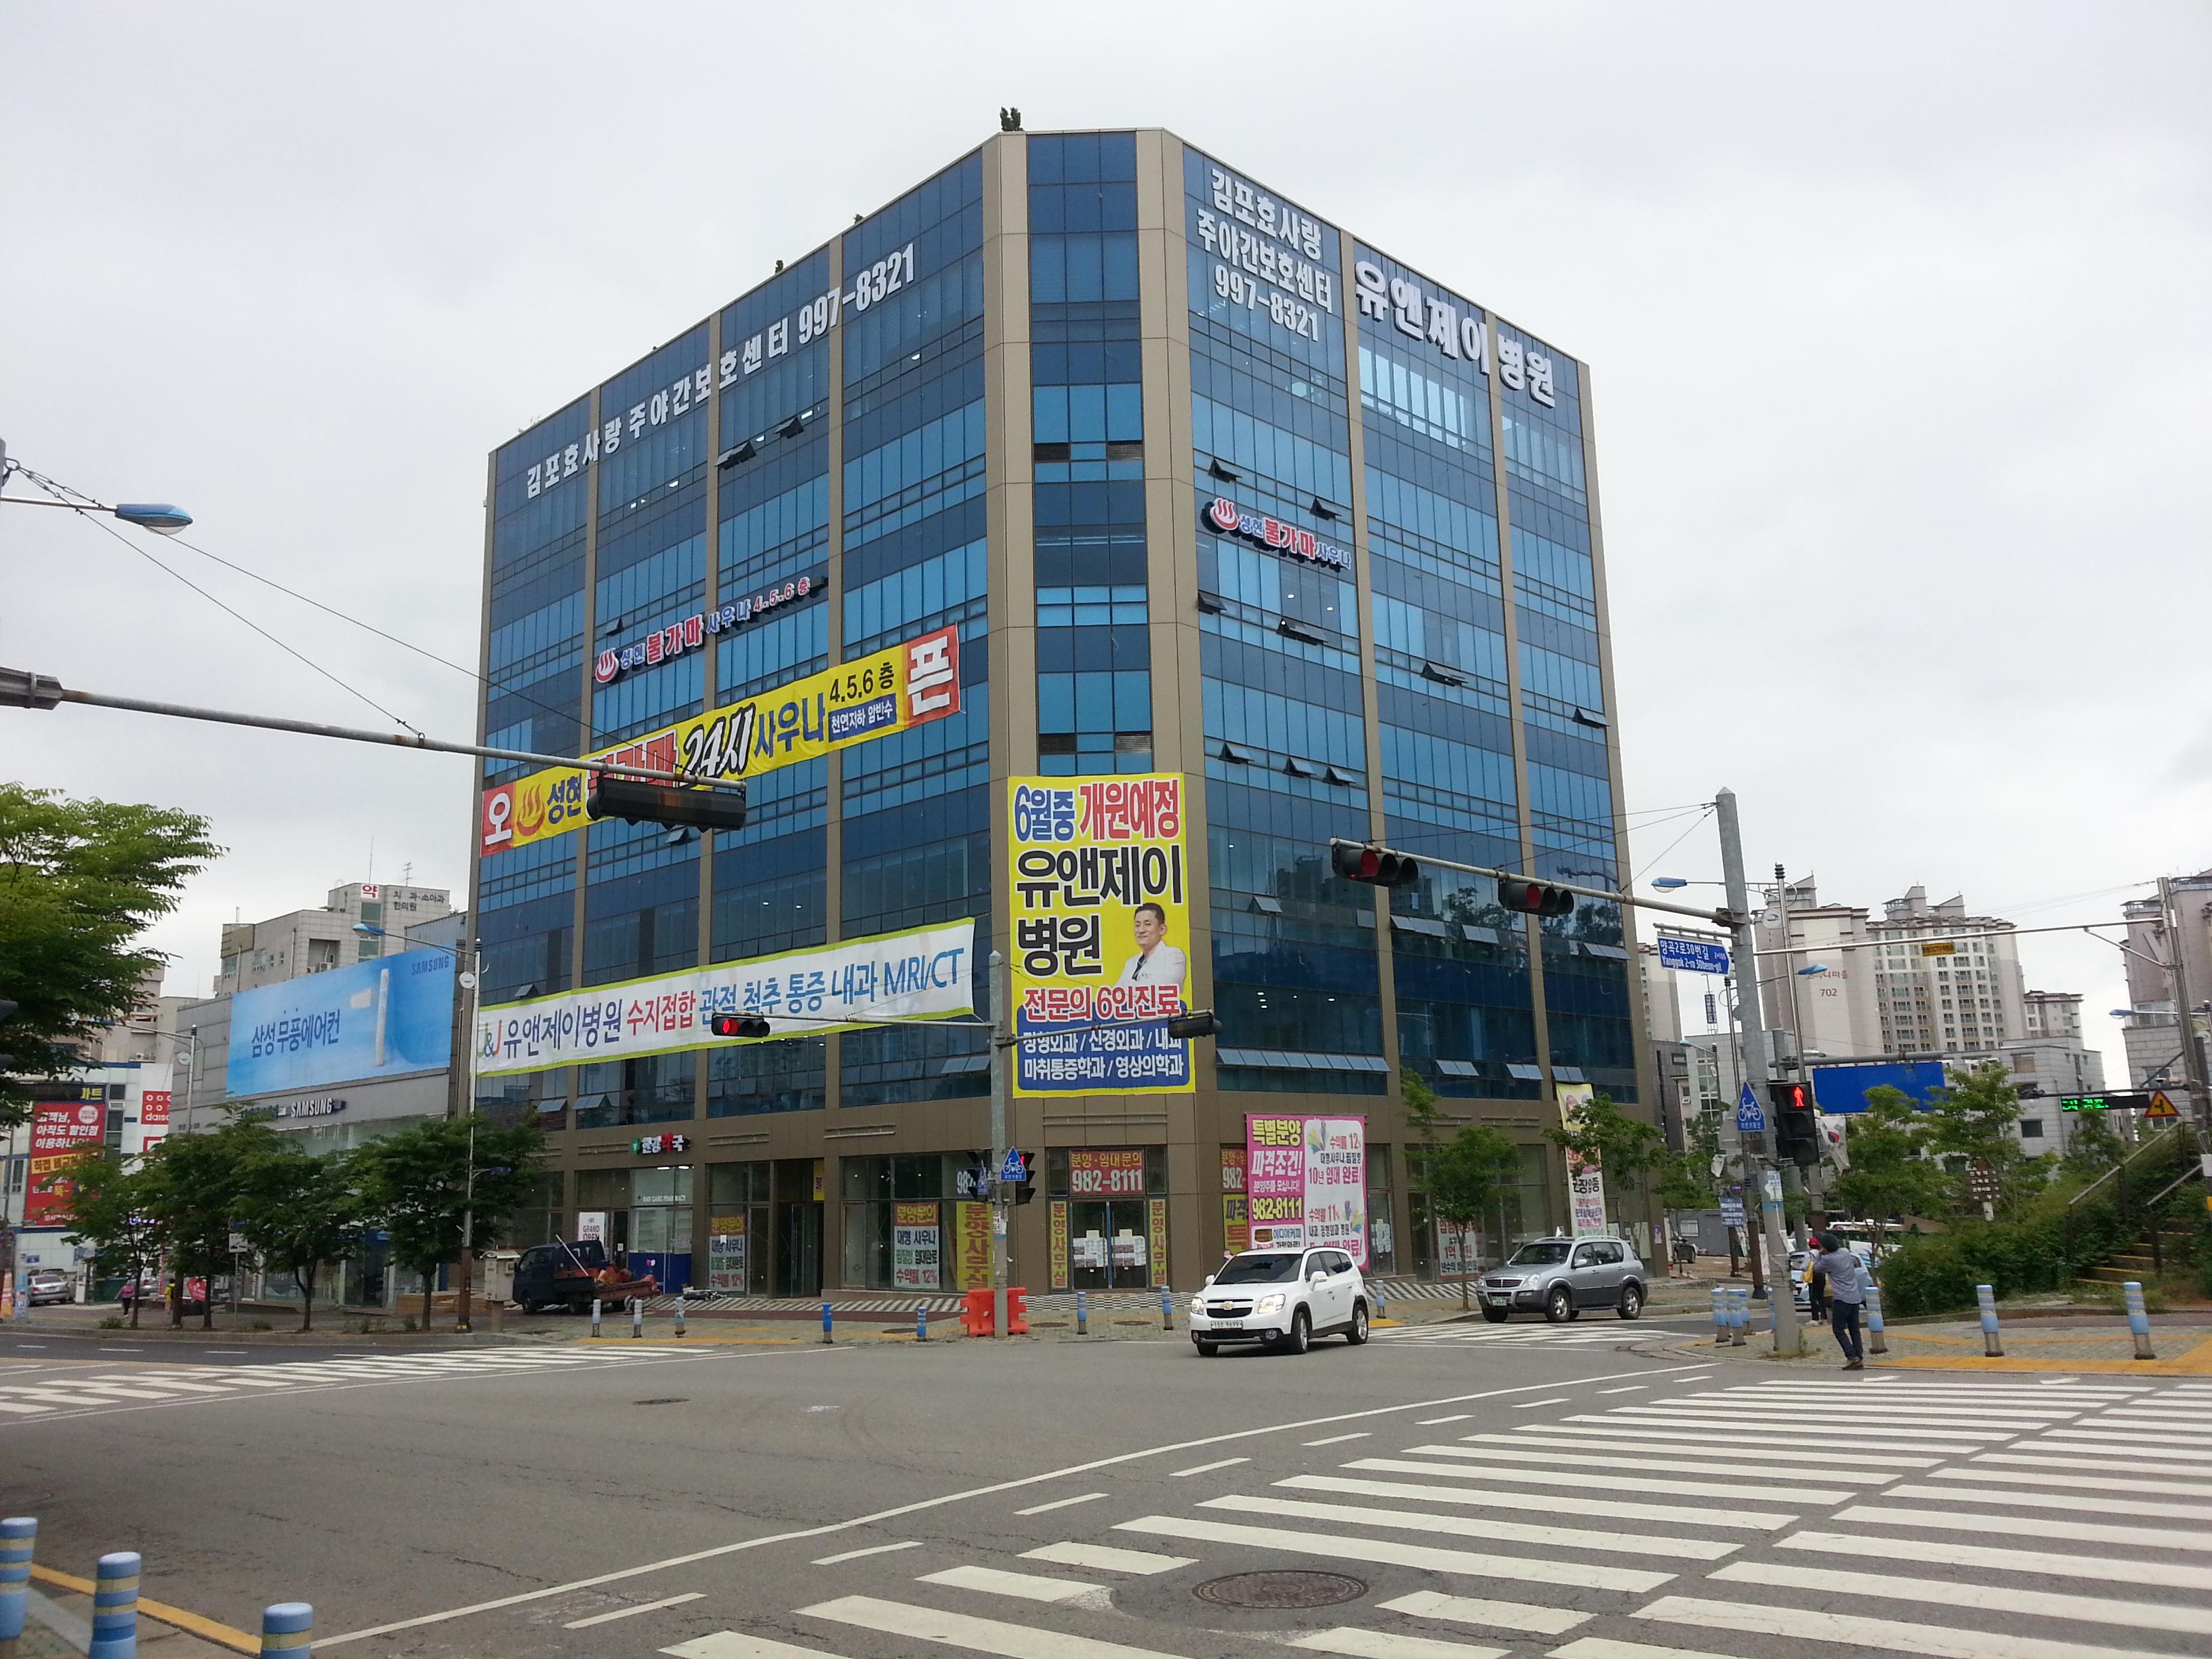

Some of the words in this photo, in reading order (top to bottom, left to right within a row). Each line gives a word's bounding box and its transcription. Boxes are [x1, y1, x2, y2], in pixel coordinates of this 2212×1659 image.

[1212, 168, 1322, 260] 김포효사랑
[1197, 208, 1332, 314] 주야간보호센터
[1215, 264, 1319, 342] 997-8321
[1355, 260, 1490, 376] 유앤제이
[1497, 333, 1556, 409] 병원
[527, 417, 622, 499] 김포효사랑
[630, 317, 789, 439] 주야간보호센터
[798, 243, 914, 344] 997-8321
[1264, 517, 1316, 560] 불가마
[1316, 542, 1352, 570] 사우나
[647, 613, 704, 665] 불가마
[706, 598, 751, 634] 사우나
[798, 576, 812, 596] 층
[830, 669, 874, 703] 4.5.6
[879, 661, 895, 690] 층
[908, 635, 954, 716] 픈
[832, 710, 866, 734] 천연지하
[868, 700, 894, 725] 암반수
[485, 792, 512, 846] 오
[547, 773, 583, 825] 성현
[754, 692, 826, 758] 사우나
[1014, 785, 1076, 842] 6월중
[1079, 779, 1180, 842] 개원예정
[362, 884, 378, 898] 약
[1017, 845, 1182, 908] 유앤제이
[393, 901, 417, 912] 한의원
[1017, 914, 1102, 977] 병원
[1660, 940, 1709, 960] 양곡2로30번길
[411, 956, 449, 976] SAMSUNG
[1662, 955, 1684, 968] Yanggok
[1024, 986, 1092, 1021] 전문의
[1097, 984, 1181, 1019] 6인진료
[1820, 988, 1837, 997] 702
[504, 999, 623, 1059] 유앤제이병원
[627, 990, 697, 1036] 수지접합
[785, 970, 826, 1013] 통증
[832, 961, 878, 1005] 내과
[252, 1022, 275, 1058] 삼성
[1088, 1029, 1145, 1051] 신경외과
[1024, 1057, 1106, 1080] 마취통증학과
[1115, 1054, 1184, 1078] 영상의학과
[291, 1097, 333, 1118] SAMSUNG
[37, 1125, 66, 1136] 아직도
[1252, 1119, 1302, 1146] 특별분양
[1251, 1150, 1303, 1176] 파격조건!
[1326, 1166, 1340, 1185] 임대
[1072, 1169, 1143, 1192] 982-8111
[897, 1205, 936, 1223] 분양문의
[1252, 1197, 1303, 1220] 982-8111
[914, 1230, 936, 1246] 사우나
[1052, 1203, 1066, 1286] 분양사무실
[1152, 1201, 1165, 1285] 분양사무실
[915, 1250, 937, 1265] 임대완료
[922, 1269, 937, 1284] 12%
